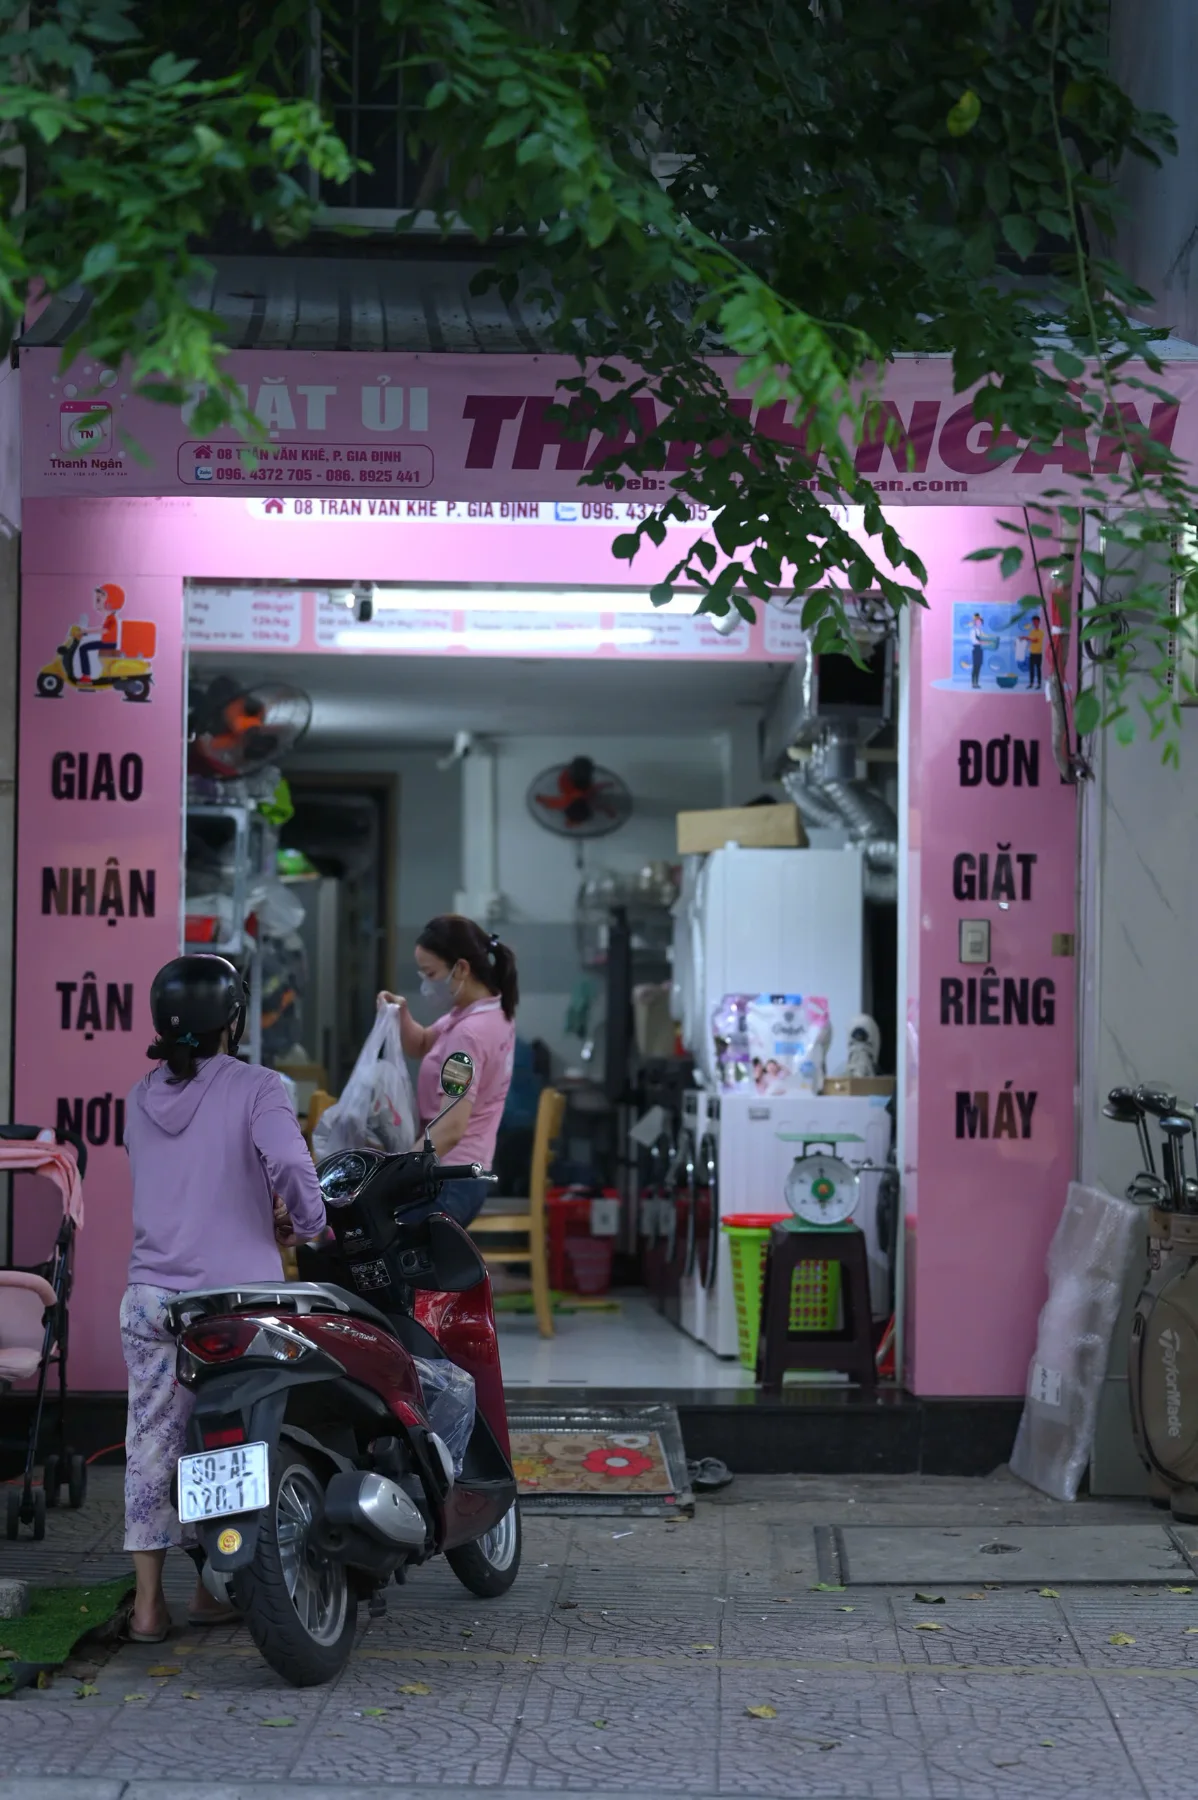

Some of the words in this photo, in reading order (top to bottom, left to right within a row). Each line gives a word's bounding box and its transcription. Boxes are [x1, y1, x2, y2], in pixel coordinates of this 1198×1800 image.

[361, 375, 429, 432] ỦI
[79, 430, 94, 439] TN
[217, 449, 232, 460] 08
[333, 450, 343, 461] P.
[347, 451, 367, 462] GIA
[370, 451, 401, 464] ĐỊNH
[49, 459, 87, 469] Thanh
[91, 458, 122, 470] Ngân
[217, 467, 245, 480] 096.
[250, 468, 283, 481] 4372
[288, 469, 312, 481] 705
[326, 469, 355, 482] 086.
[360, 470, 392, 482] 8925
[396, 470, 420, 482] 441
[294, 500, 313, 515] 08
[447, 501, 461, 518] P.
[467, 501, 494, 518] GIA
[500, 501, 539, 521] ĐỊNH
[582, 503, 619, 520] 096.
[51, 751, 144, 801] GIAO
[958, 734, 1039, 787] ĐƠN
[42, 857, 156, 926] NHẬN
[56, 971, 134, 1040] TẬN
[940, 967, 1056, 1026] RIÊNG
[56, 1092, 125, 1146] NƠI
[955, 1080, 1038, 1139] MÁY
